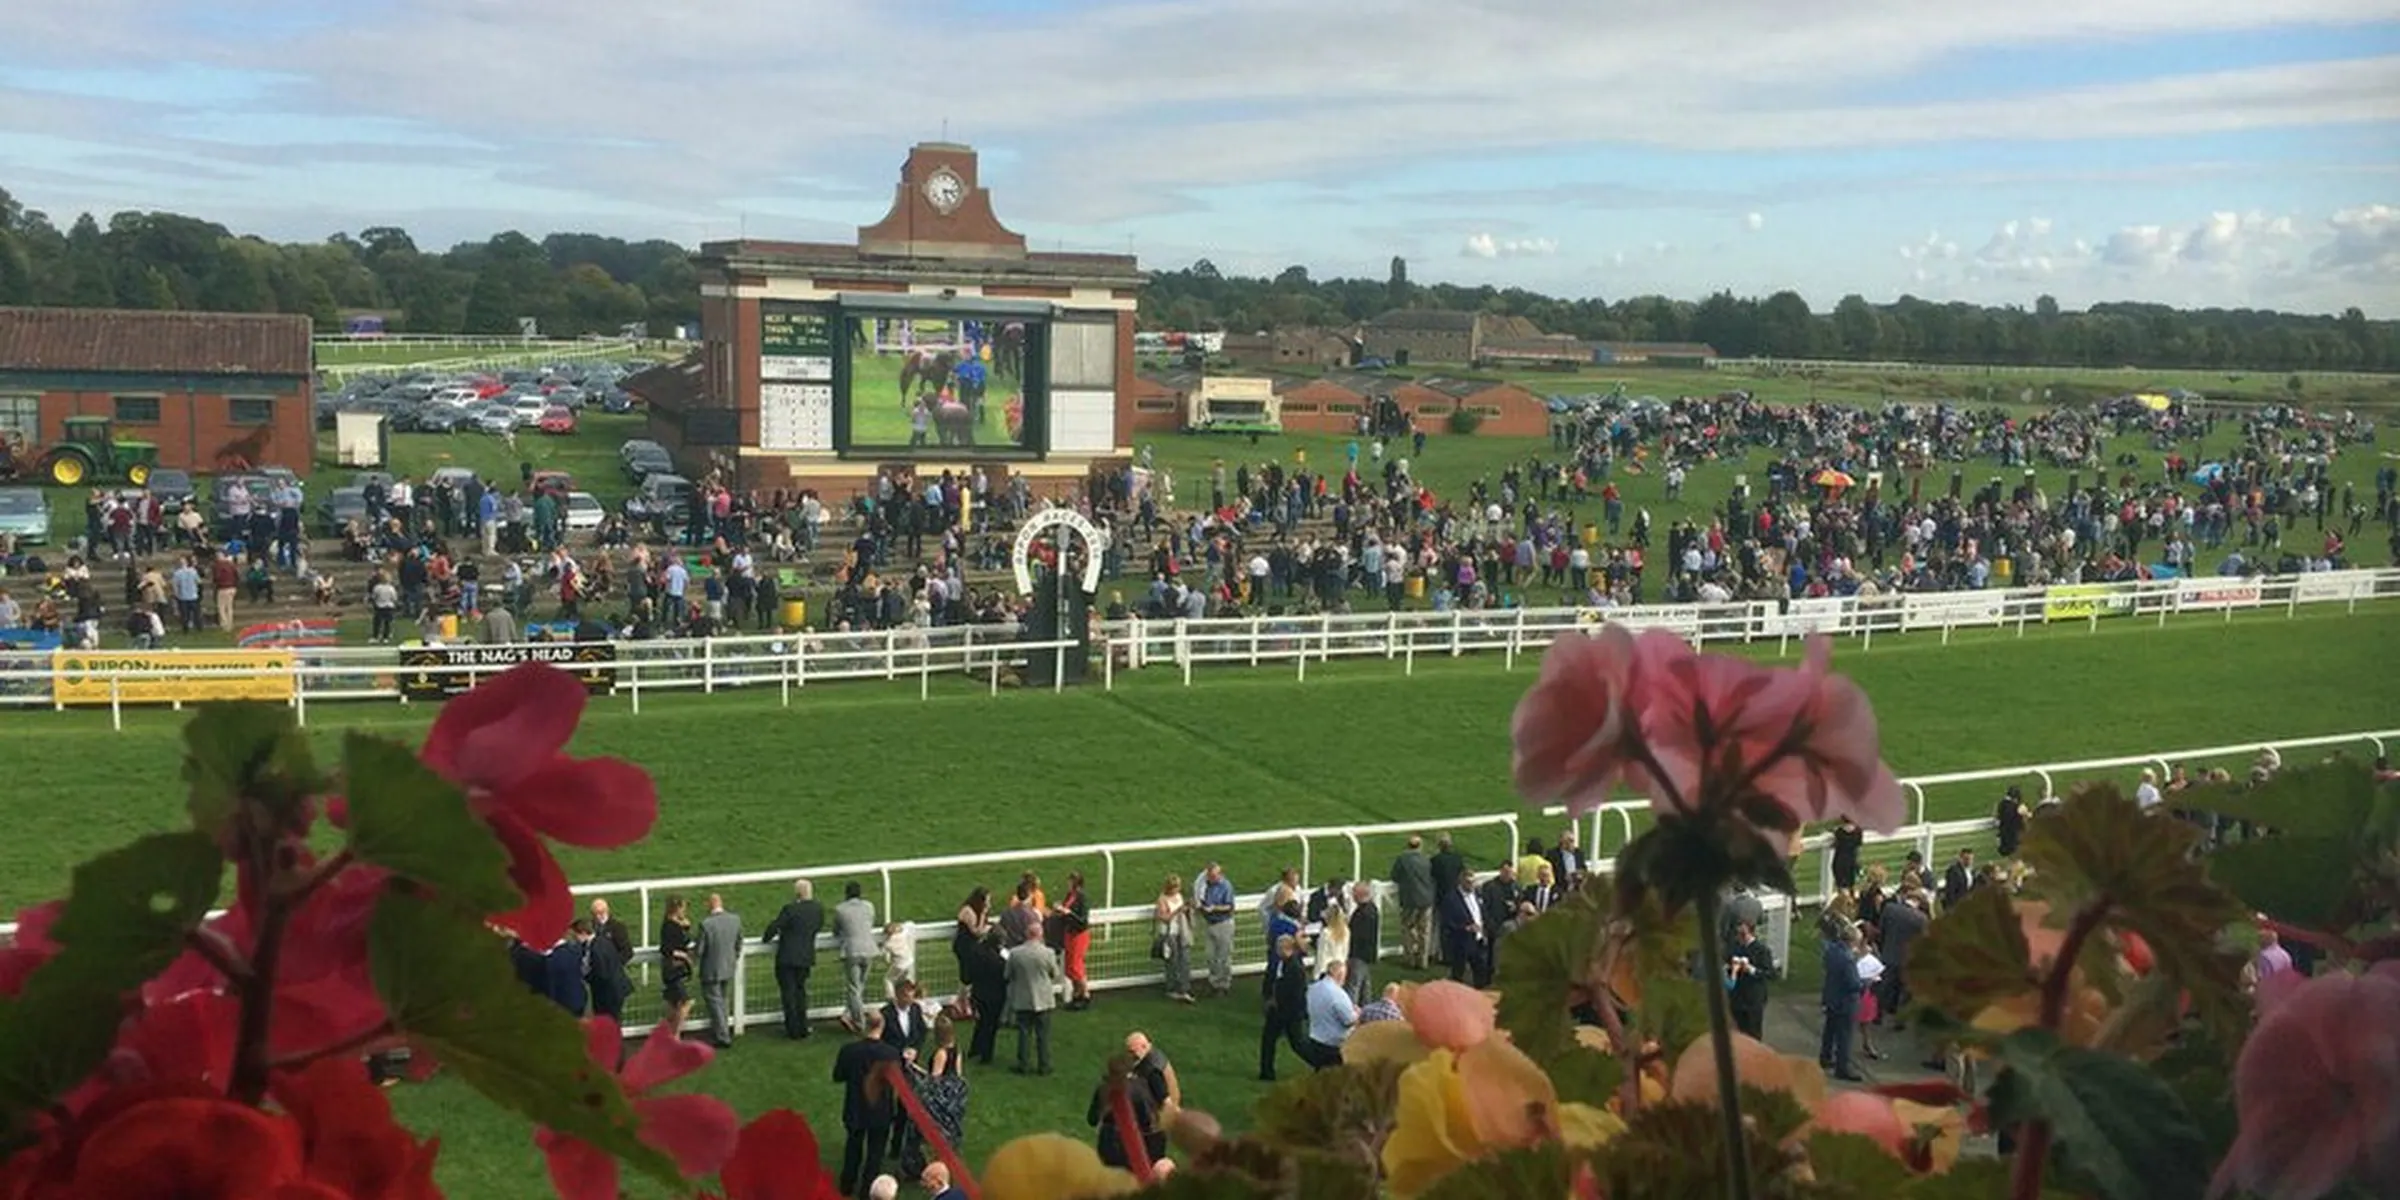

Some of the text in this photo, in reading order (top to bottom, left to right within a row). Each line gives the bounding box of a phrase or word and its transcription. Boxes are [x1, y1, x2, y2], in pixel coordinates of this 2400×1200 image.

[447, 648, 574, 664] THE NAG'S HEAD
[88, 659, 150, 671] RIPON
